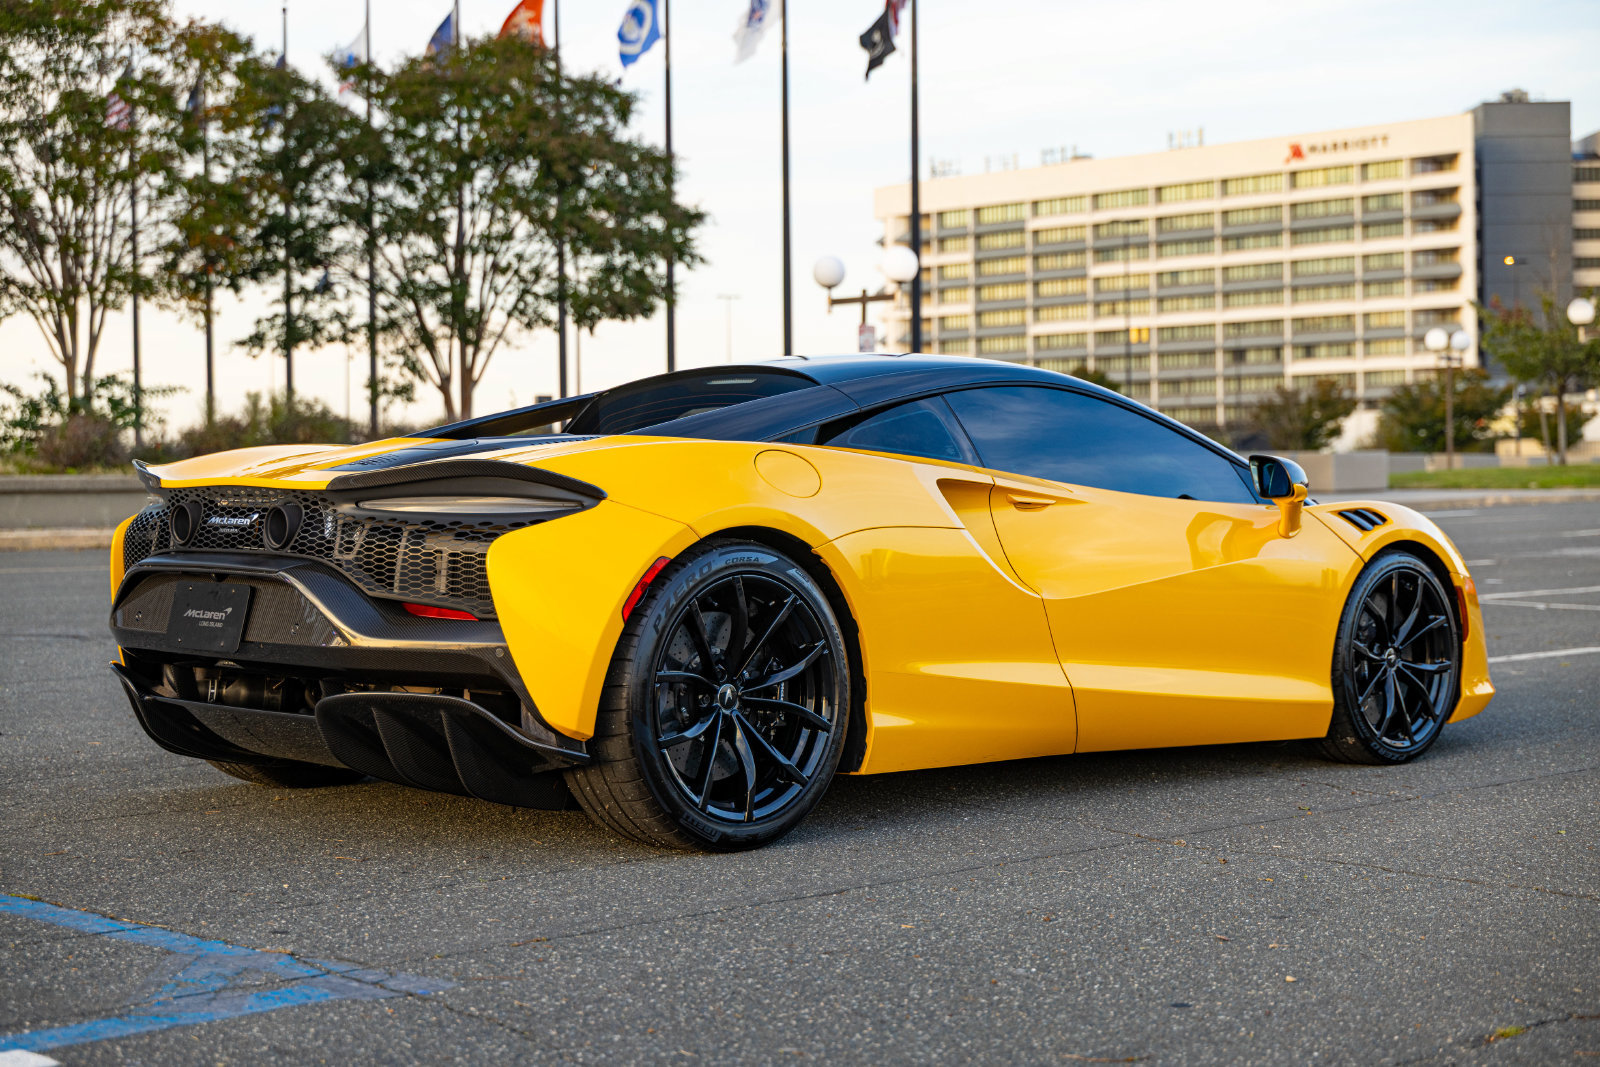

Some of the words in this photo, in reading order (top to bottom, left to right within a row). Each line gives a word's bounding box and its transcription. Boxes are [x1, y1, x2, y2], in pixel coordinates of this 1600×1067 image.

[1308, 133, 1389, 153] MARRIOTT
[207, 515, 252, 526] McLaren
[725, 556, 760, 566] CORSA
[183, 608, 226, 620] McLaren
